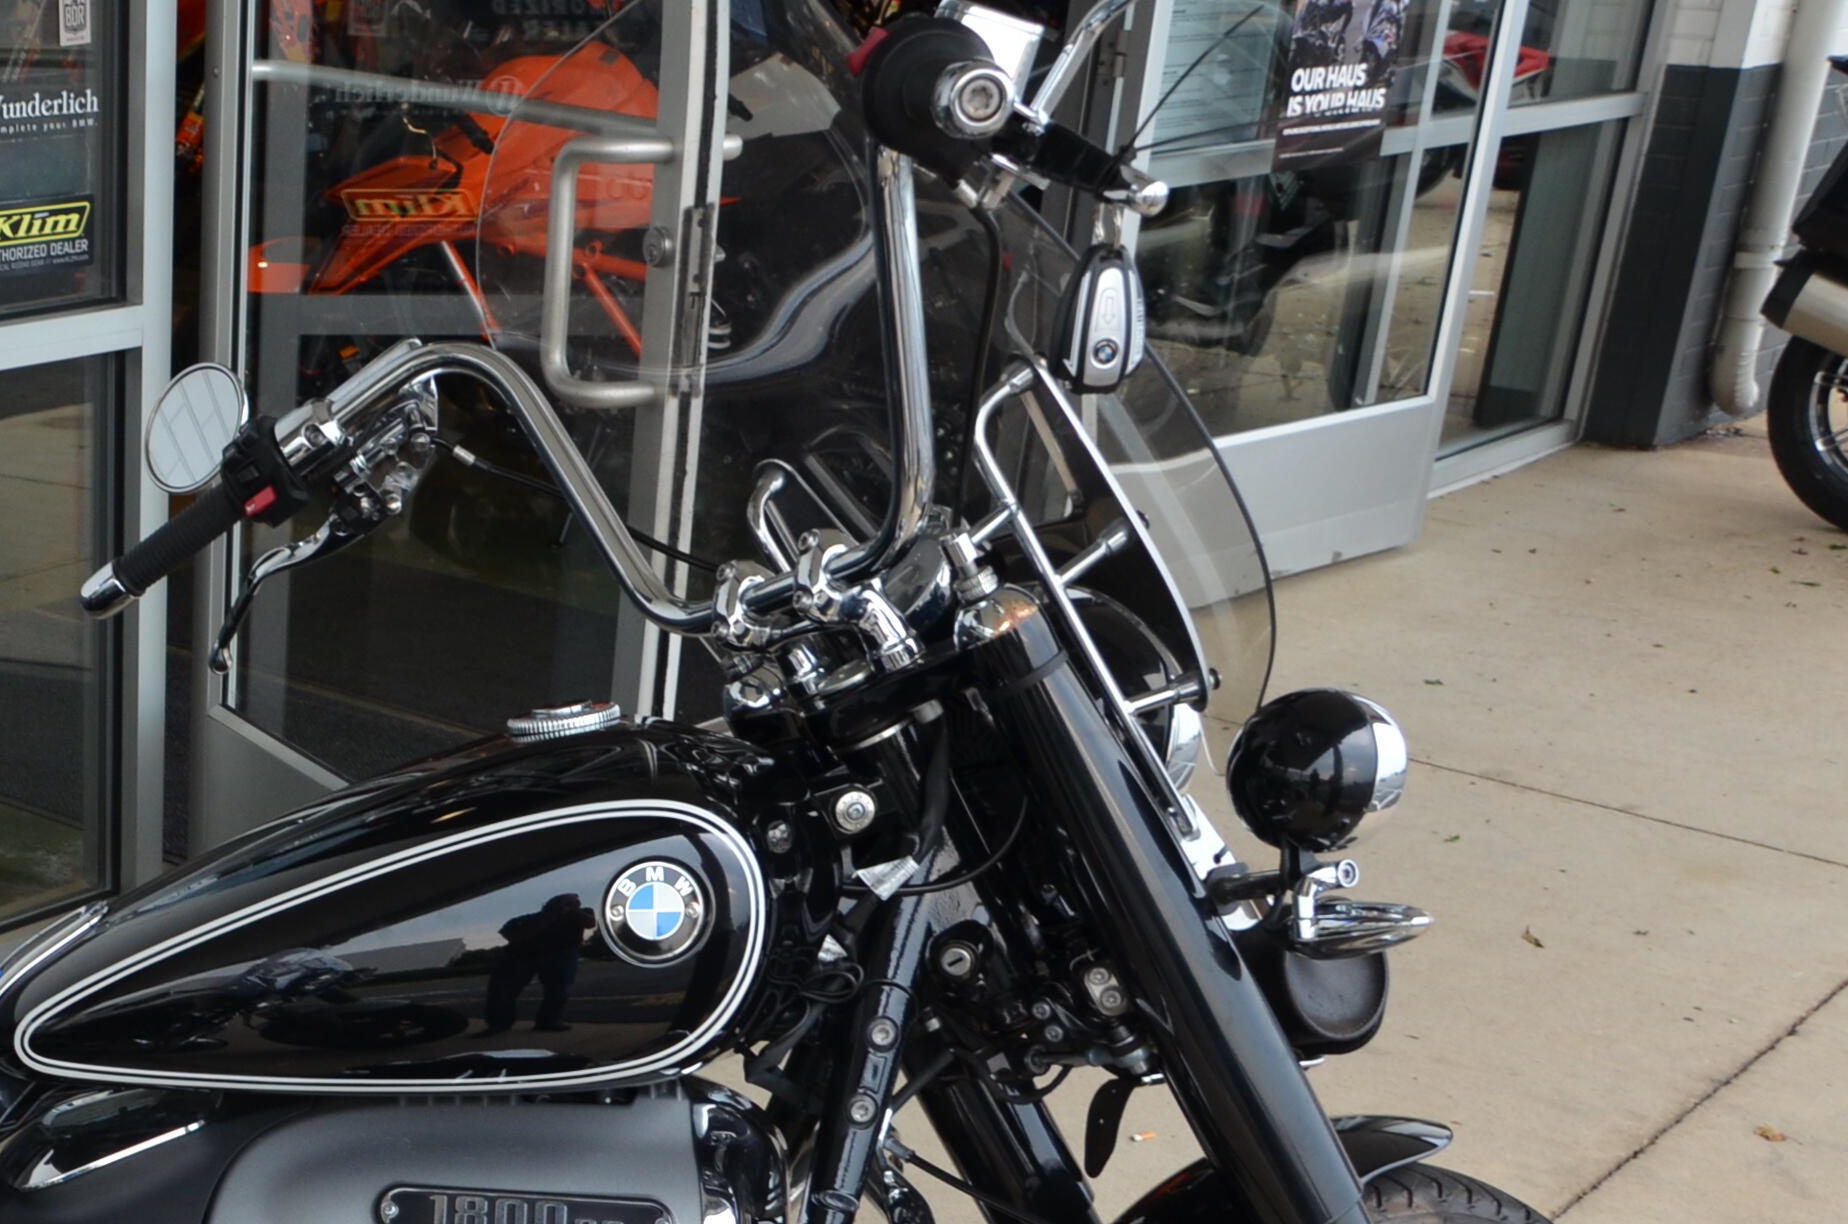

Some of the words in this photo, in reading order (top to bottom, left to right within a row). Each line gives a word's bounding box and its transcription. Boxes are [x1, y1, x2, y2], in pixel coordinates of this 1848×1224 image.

[1291, 66, 1326, 93] OUR
[1326, 62, 1368, 89] HAUS
[1286, 95, 1304, 117] IS
[1345, 87, 1386, 113] HAUS
[49, 238, 89, 257] DEALER
[616, 866, 694, 897] BMW
